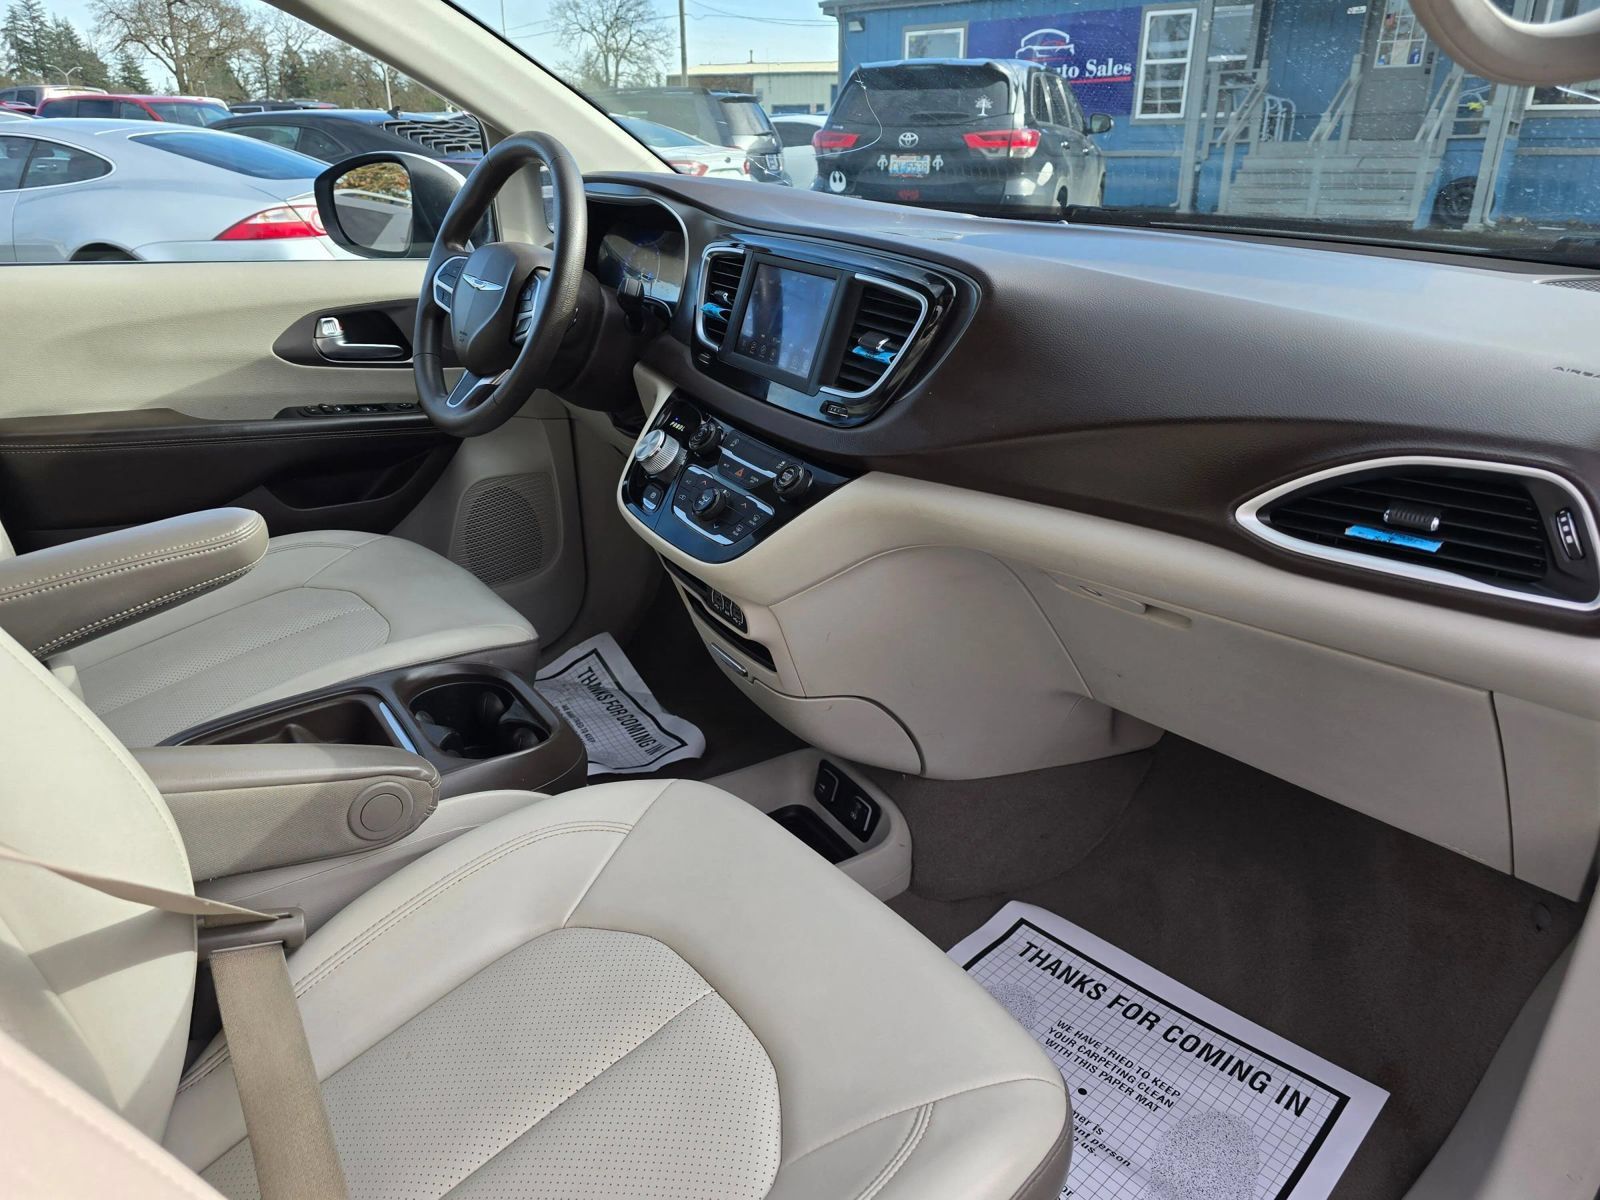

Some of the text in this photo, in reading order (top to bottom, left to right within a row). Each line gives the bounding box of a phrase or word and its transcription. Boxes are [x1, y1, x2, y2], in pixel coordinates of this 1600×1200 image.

[1052, 58, 1132, 79] to Sales
[602, 699, 628, 717] FOR
[617, 714, 657, 748] COMING
[1018, 941, 1311, 1118] THANKS FOR COMING IN
[1045, 1038, 1161, 1113] WITH THIS PAPER MAT
[1048, 1027, 1175, 1108] YOUR CARPETING CLEAN
[1057, 1020, 1181, 1098] WE HAVE TRIED TO KEEP
[1081, 1142, 1097, 1157] us.
[1090, 1138, 1131, 1167] person
[1092, 1124, 1104, 1135] is
